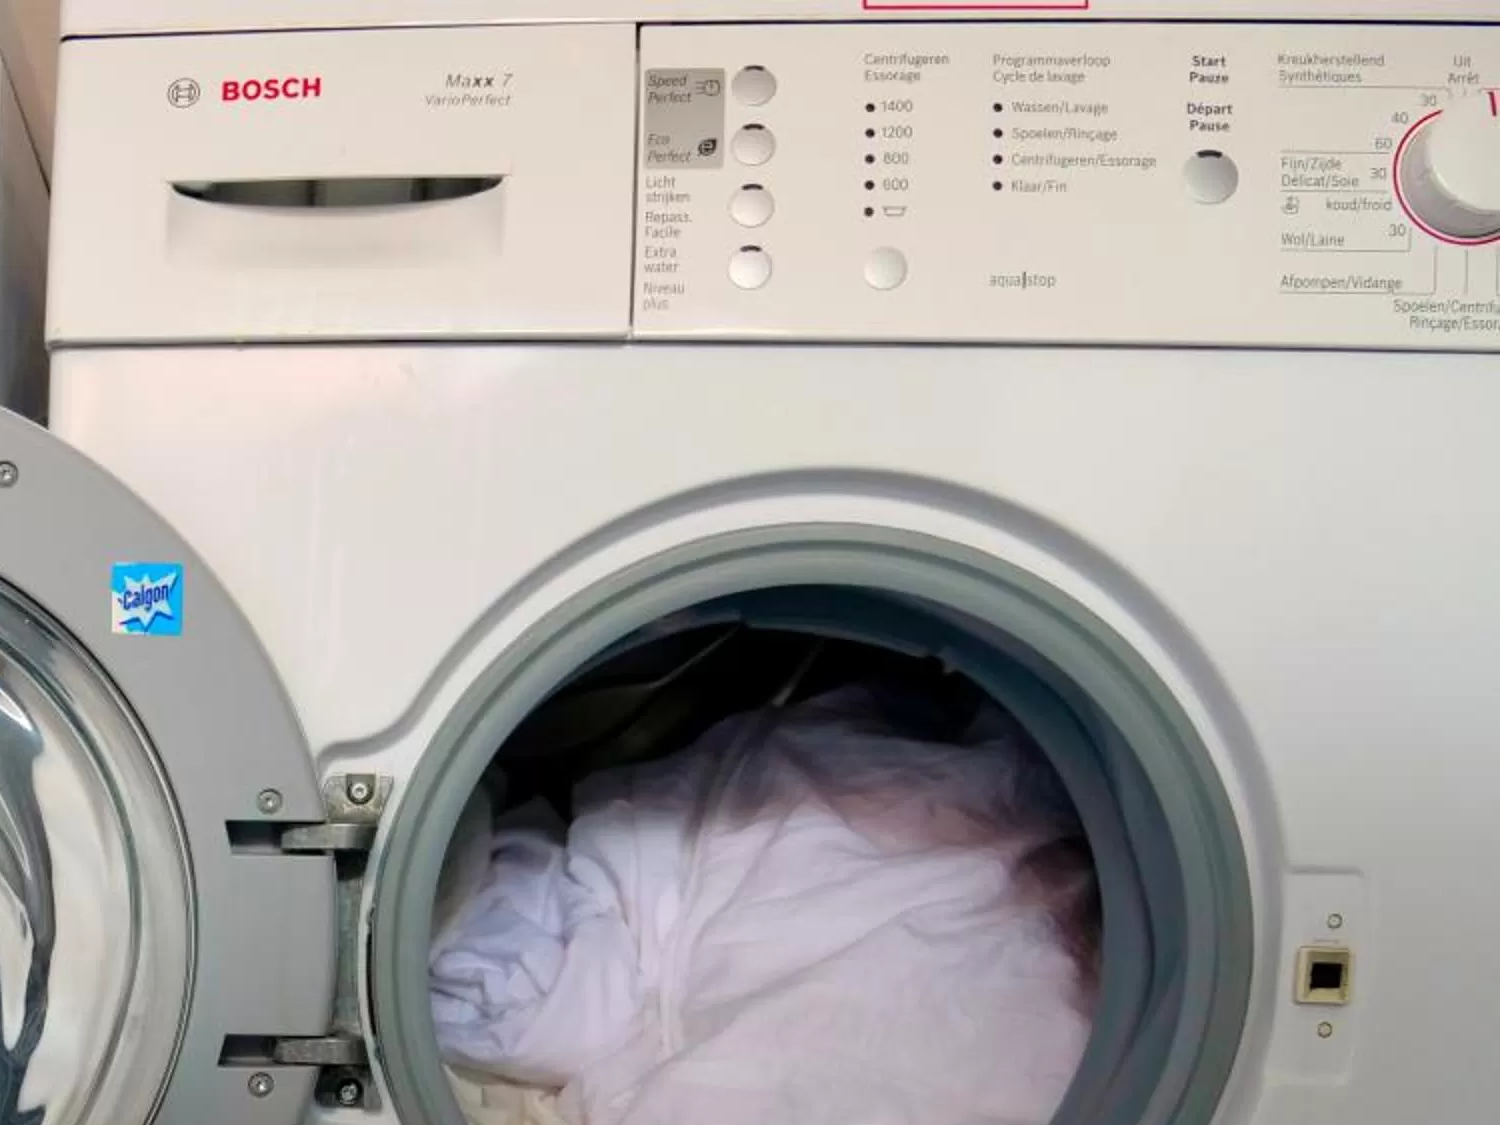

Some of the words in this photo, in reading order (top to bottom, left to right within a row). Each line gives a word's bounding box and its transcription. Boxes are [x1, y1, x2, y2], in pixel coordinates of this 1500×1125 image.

[864, 53, 950, 67] Centrifugeren
[993, 53, 1111, 69] Programmaverloop
[1192, 55, 1226, 67] Start
[1278, 54, 1385, 67] Kreukherstellend
[1453, 55, 1471, 68] Uit
[445, 73, 495, 89] Maxx
[502, 73, 513, 88] 7
[648, 75, 688, 89] Speed
[864, 70, 921, 84] Essorage
[993, 70, 1026, 84] Cycle
[1028, 70, 1044, 82] de
[1047, 70, 1085, 84] lavage
[1189, 72, 1229, 84] Pauze
[221, 77, 322, 102] BOSCH
[424, 93, 511, 108] VarioPerfect
[647, 91, 692, 104] Perfect
[880, 101, 914, 113] 1400
[1011, 101, 1109, 117] Wassen/Lavage
[1186, 102, 1233, 118] Départ
[1391, 111, 1409, 124] 40
[881, 126, 913, 139] 1200
[1189, 120, 1230, 132] Pause
[647, 133, 670, 146] Eco
[1374, 138, 1393, 150] 60
[647, 150, 692, 164] Perfect
[1370, 168, 1387, 181] 30
[645, 175, 676, 189] Licht
[1011, 180, 1067, 194] Klaar/Fin
[1389, 225, 1406, 237] 30
[1281, 233, 1345, 247] Wol/Laine
[644, 246, 677, 259] Extra
[1280, 275, 1403, 291] Afpompen/Vidange
[122, 583, 169, 613] Calgon
